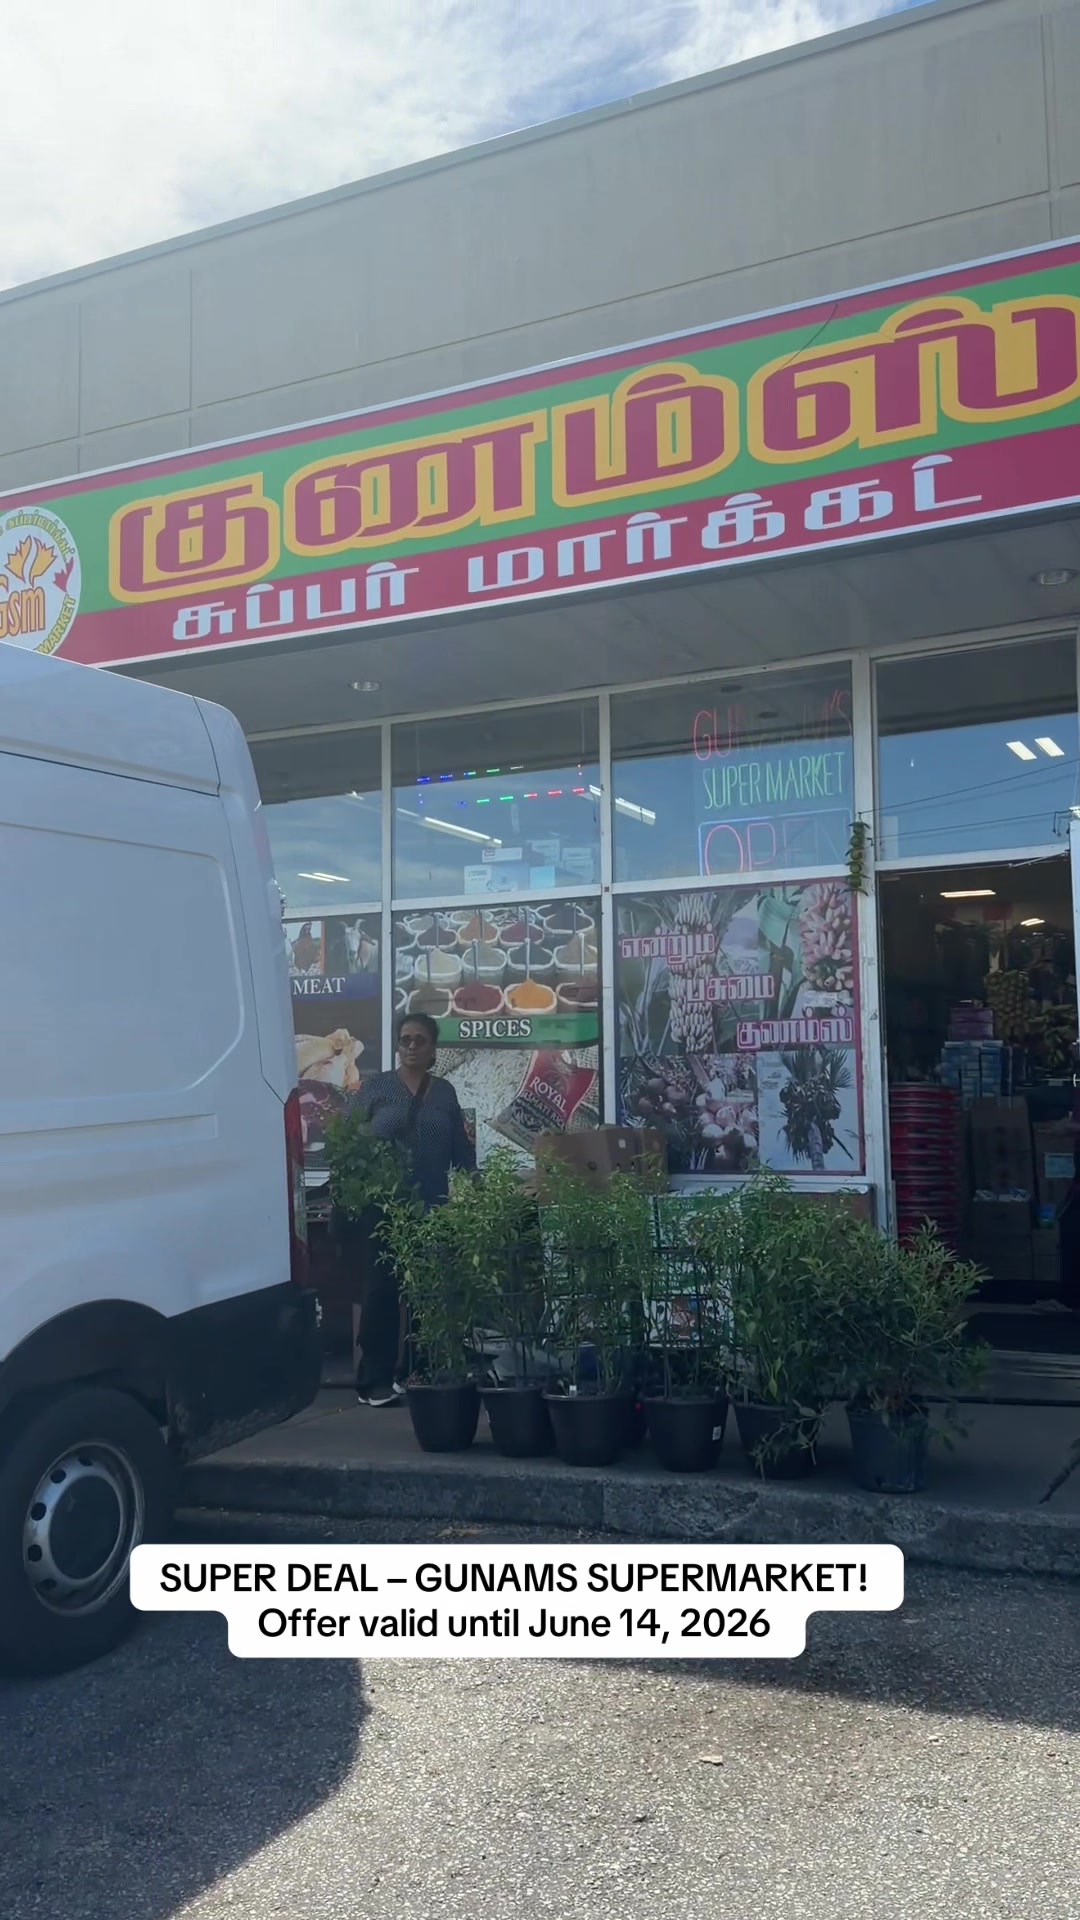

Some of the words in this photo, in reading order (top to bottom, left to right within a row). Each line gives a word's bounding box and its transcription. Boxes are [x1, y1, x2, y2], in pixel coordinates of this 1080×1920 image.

[292, 976, 346, 996] MEAT
[459, 1018, 532, 1038] SPICES
[529, 1076, 567, 1113] ROYAL
